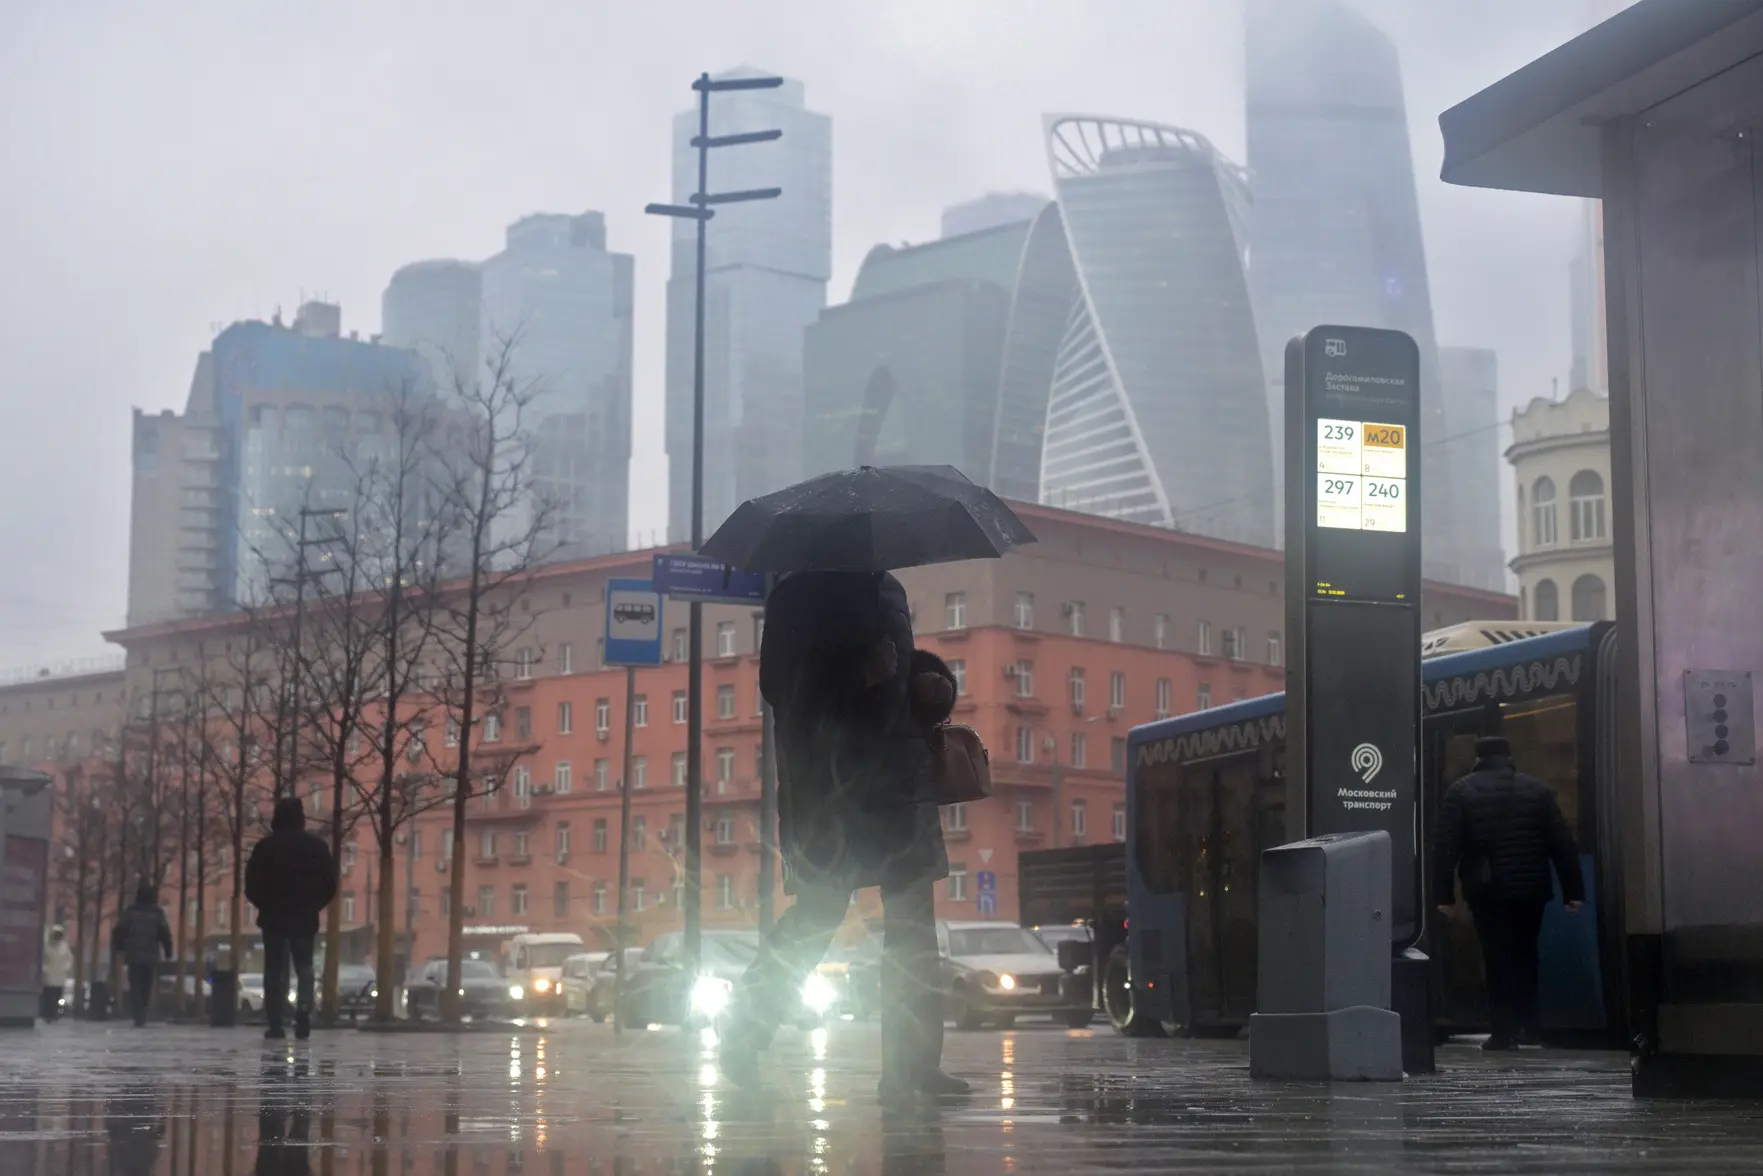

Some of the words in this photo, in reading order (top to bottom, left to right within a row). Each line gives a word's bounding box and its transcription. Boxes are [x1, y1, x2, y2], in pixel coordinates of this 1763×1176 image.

[1325, 372, 1405, 386] Дорогомиловская
[1325, 382, 1360, 392] Застава
[1324, 425, 1354, 441] 239
[1319, 461, 1325, 469] 4
[1324, 479, 1354, 495] 297
[1368, 482, 1399, 498] 240
[1337, 788, 1397, 798] Московский
[1342, 800, 1392, 811] транспорт
